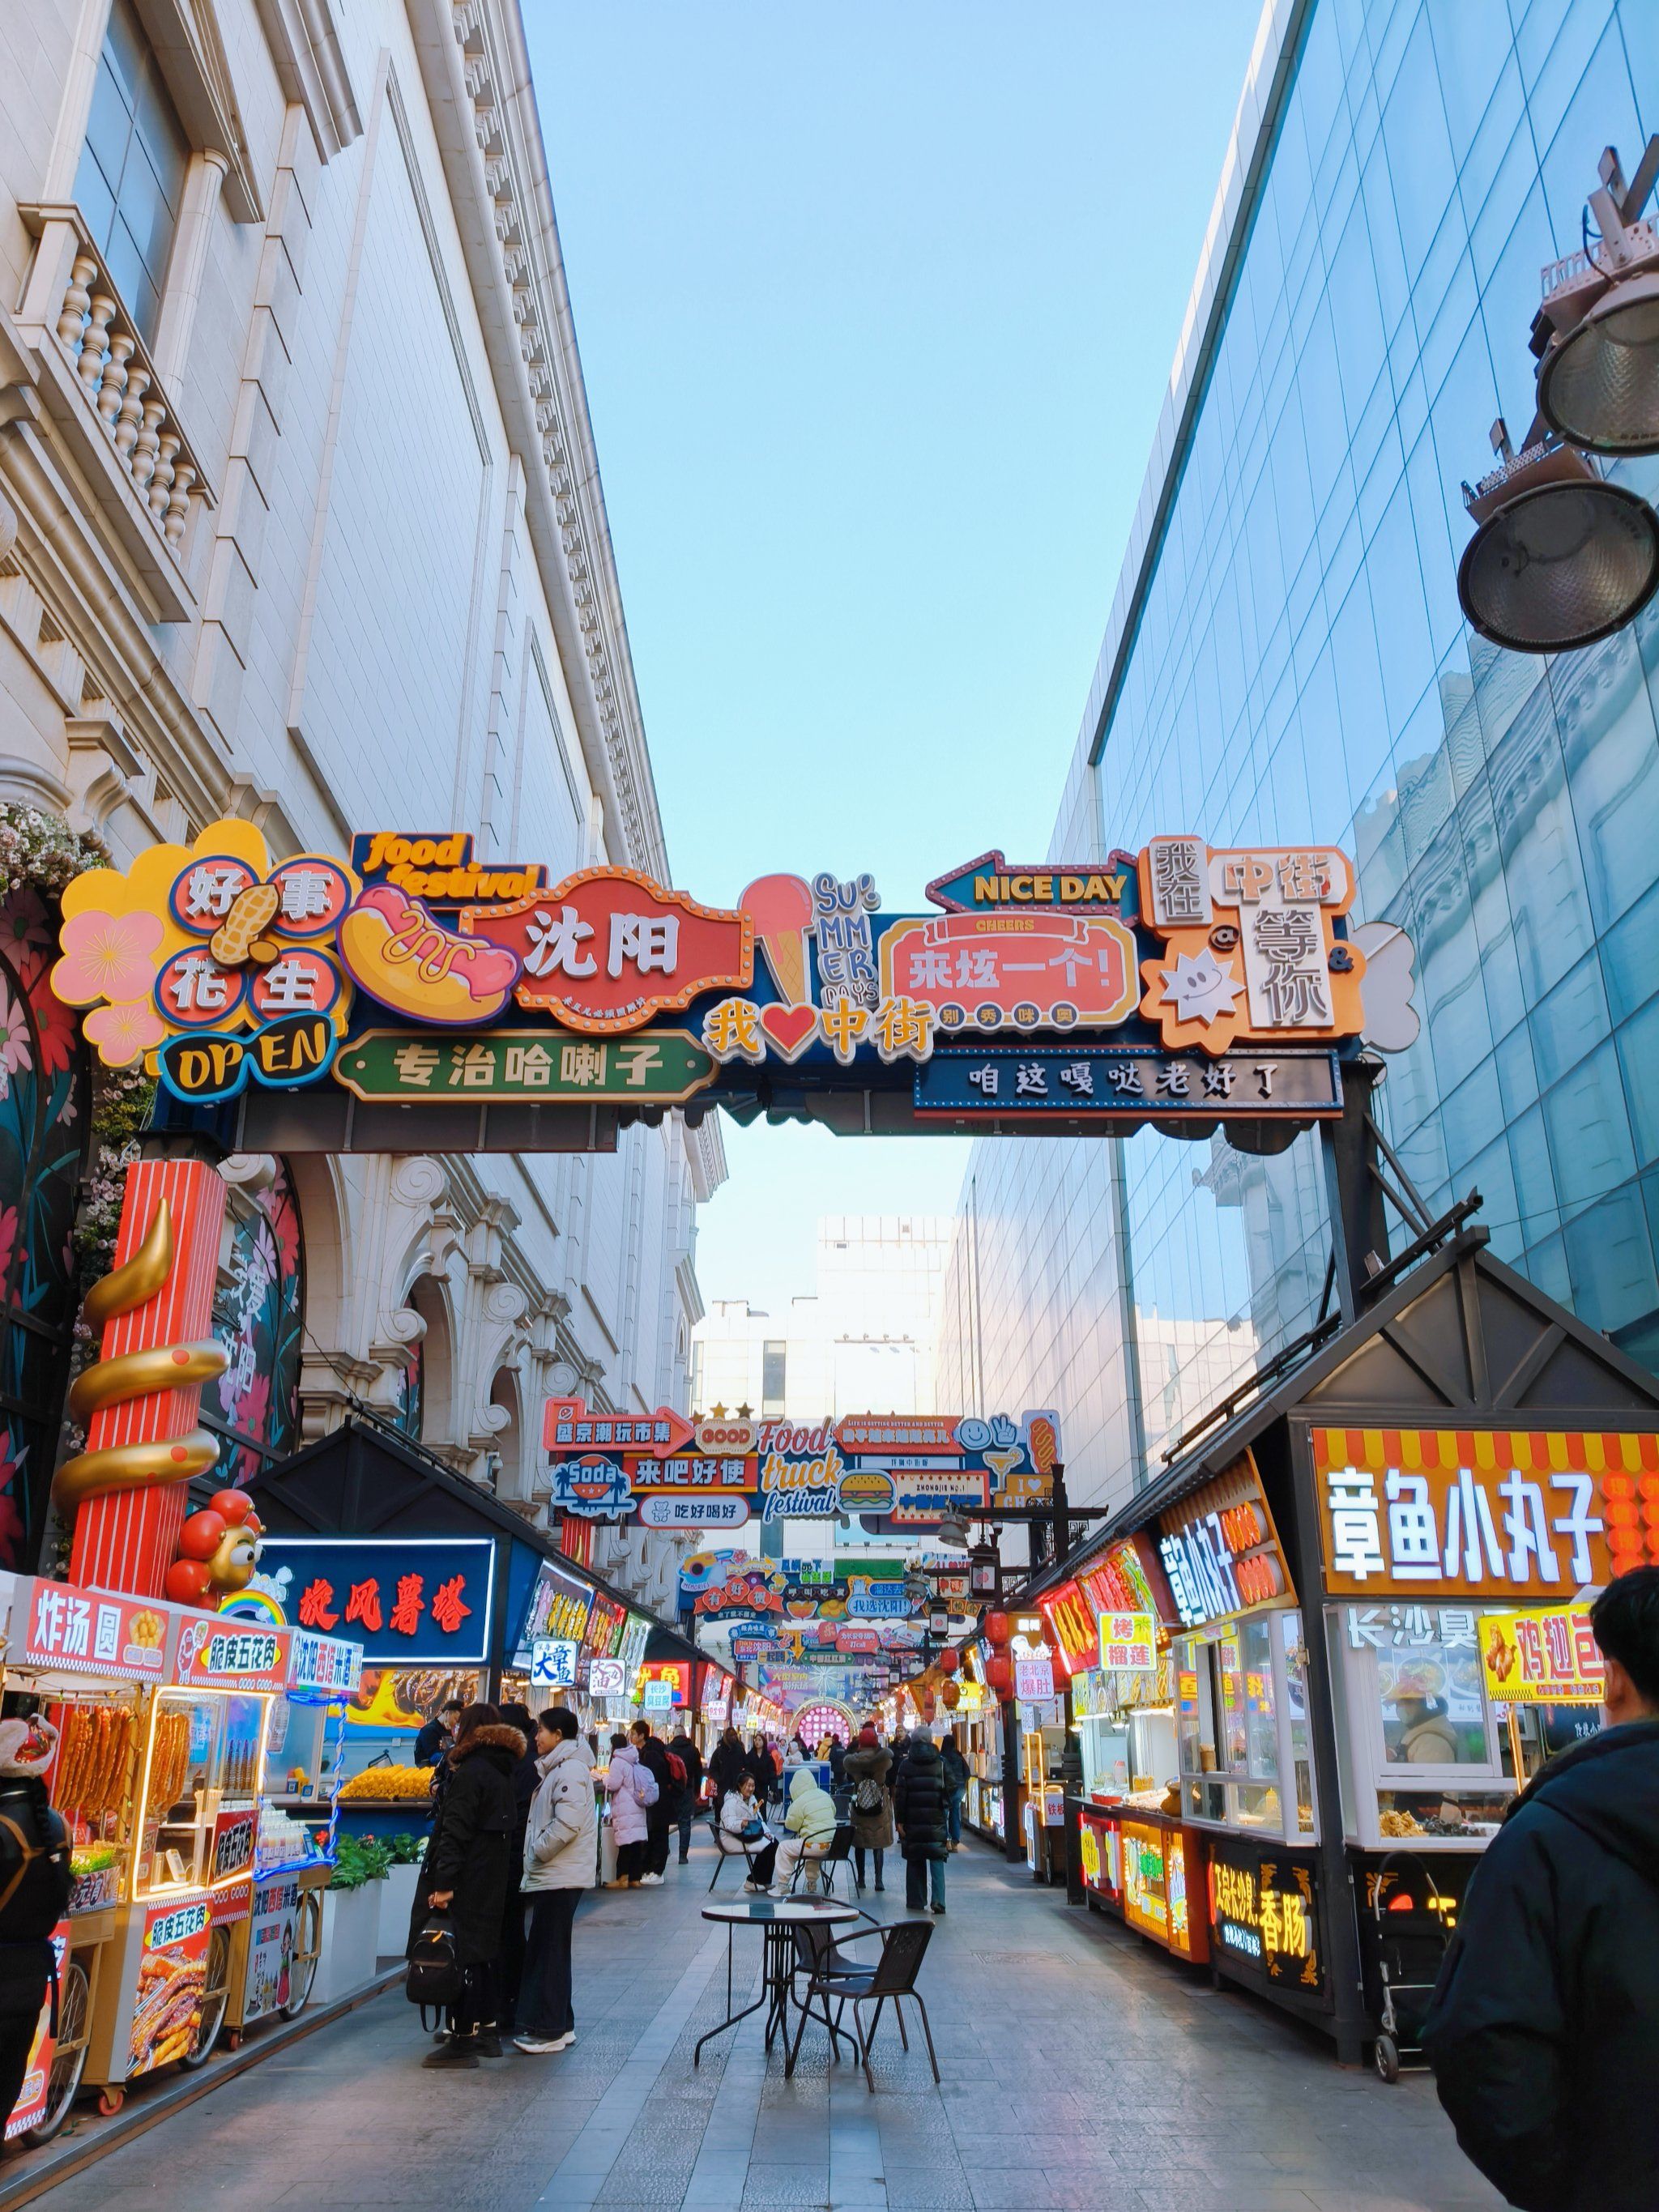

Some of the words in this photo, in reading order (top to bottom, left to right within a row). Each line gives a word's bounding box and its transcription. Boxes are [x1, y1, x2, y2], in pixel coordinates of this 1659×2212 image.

[363, 833, 467, 872] food
[186, 867, 335, 921] 好事
[386, 863, 540, 900] festival
[975, 876, 1053, 903] NICE
[1060, 876, 1127, 903] DAY
[1156, 842, 1204, 920] 我在
[1223, 855, 1333, 900] 中街
[523, 906, 680, 979] 沈阳
[976, 919, 1034, 932] CHEERS
[171, 957, 318, 1012] 花生
[910, 948, 1110, 990] 来炫一个!
[1256, 909, 1328, 1023] 等你
[821, 997, 933, 1055] 中街
[942, 1006, 1075, 1026] 别秀咪奥
[179, 1021, 326, 1089] OPEN
[393, 1043, 664, 1086] 专治哈喇子
[969, 1061, 1280, 1096] 咱这嘎哒老好了
[556, 1422, 672, 1443] 盛京潮玩市集
[702, 1428, 751, 1444] GOOD
[759, 1417, 832, 1454] Food
[569, 1460, 617, 1485] Soda
[635, 1459, 746, 1485] 来吧好使
[762, 1448, 843, 1491] truck
[916, 1484, 948, 1492] ZHONGJIE
[674, 1503, 737, 1519] 吃好喝好
[763, 1491, 836, 1524] festival
[1327, 1467, 1603, 1584] 章鱼小丸子
[683, 1582, 710, 1591] MEMORIES
[1159, 1511, 1242, 1627] 章鱼小丸子
[298, 1572, 473, 1636] 旋风薯塔
[874, 1583, 906, 1595] 溜达去
[34, 1588, 122, 1662] 炸汤圆
[1113, 1618, 1133, 1639] 烤
[1348, 1605, 1523, 1649] 长沙臭
[208, 1634, 277, 1673] 脆皮五花肉
[533, 1645, 573, 1684] 大章鱼
[1020, 1664, 1050, 1677] 老北京
[1107, 1645, 1150, 1666] 榴莲
[1021, 1679, 1051, 1695] 爆肚
[1047, 1803, 1064, 1816] 铁板
[1214, 1863, 1258, 1926] 正宗长沙臭
[151, 1903, 207, 1950] 脆皮五花肉
[1259, 1890, 1306, 1958] 香肠
